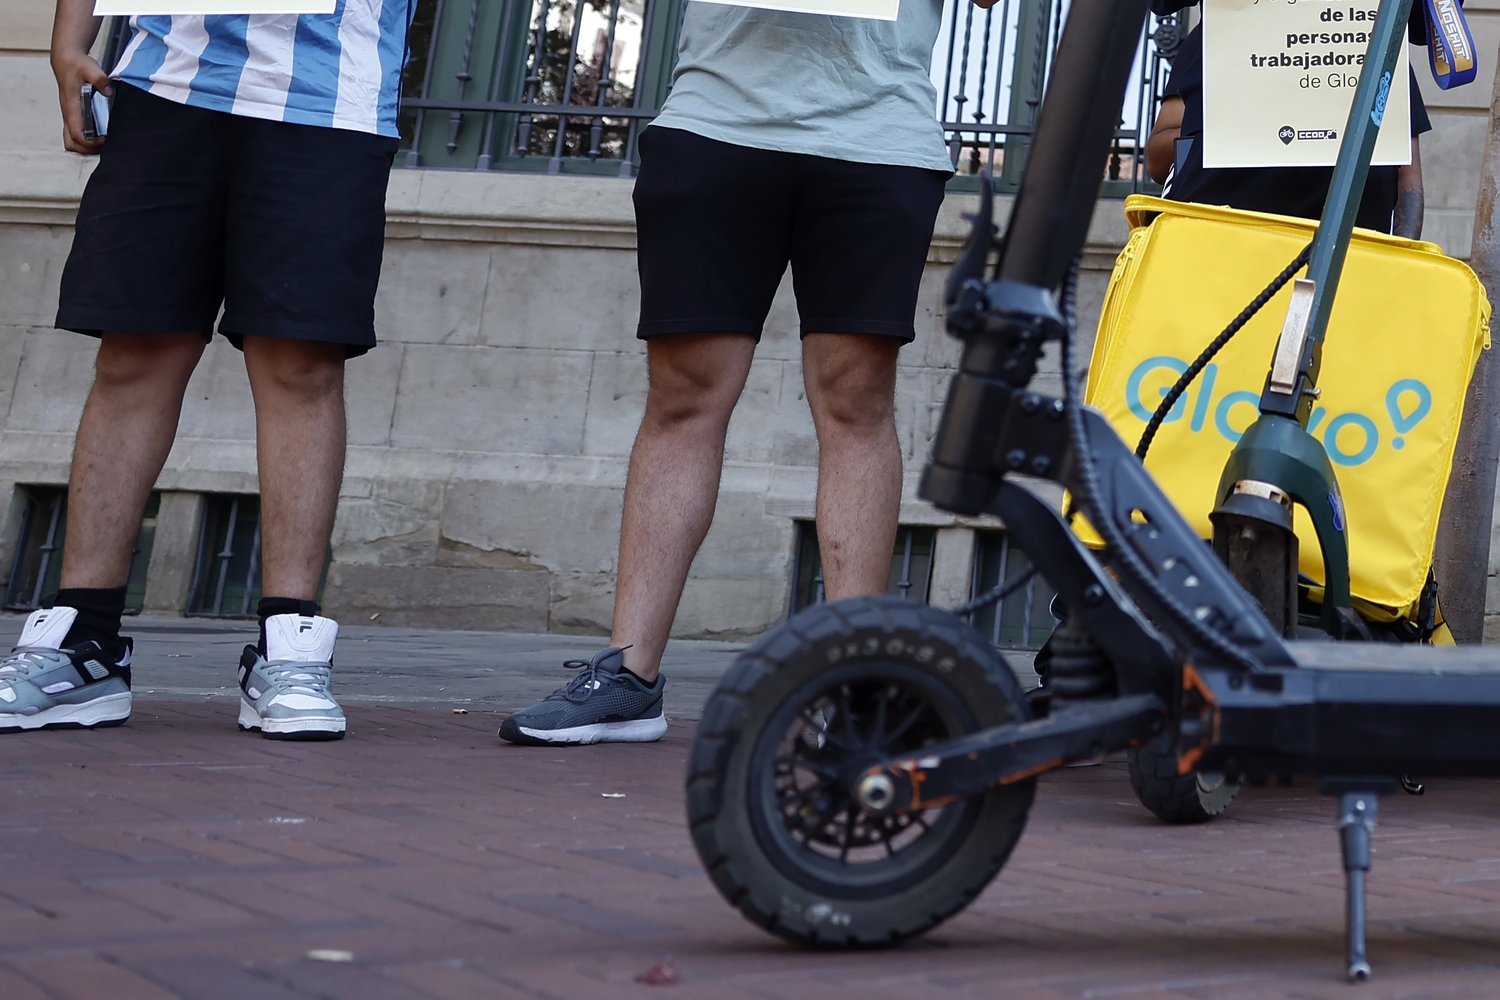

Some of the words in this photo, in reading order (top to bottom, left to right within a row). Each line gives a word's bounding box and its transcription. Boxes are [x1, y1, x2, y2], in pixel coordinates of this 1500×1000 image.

[1320, 7, 1344, 22] de
[1350, 7, 1377, 22] las
[1251, 52, 1365, 70] trabajadora
[1300, 74, 1320, 88] de
[1327, 72, 1358, 88] Glo
